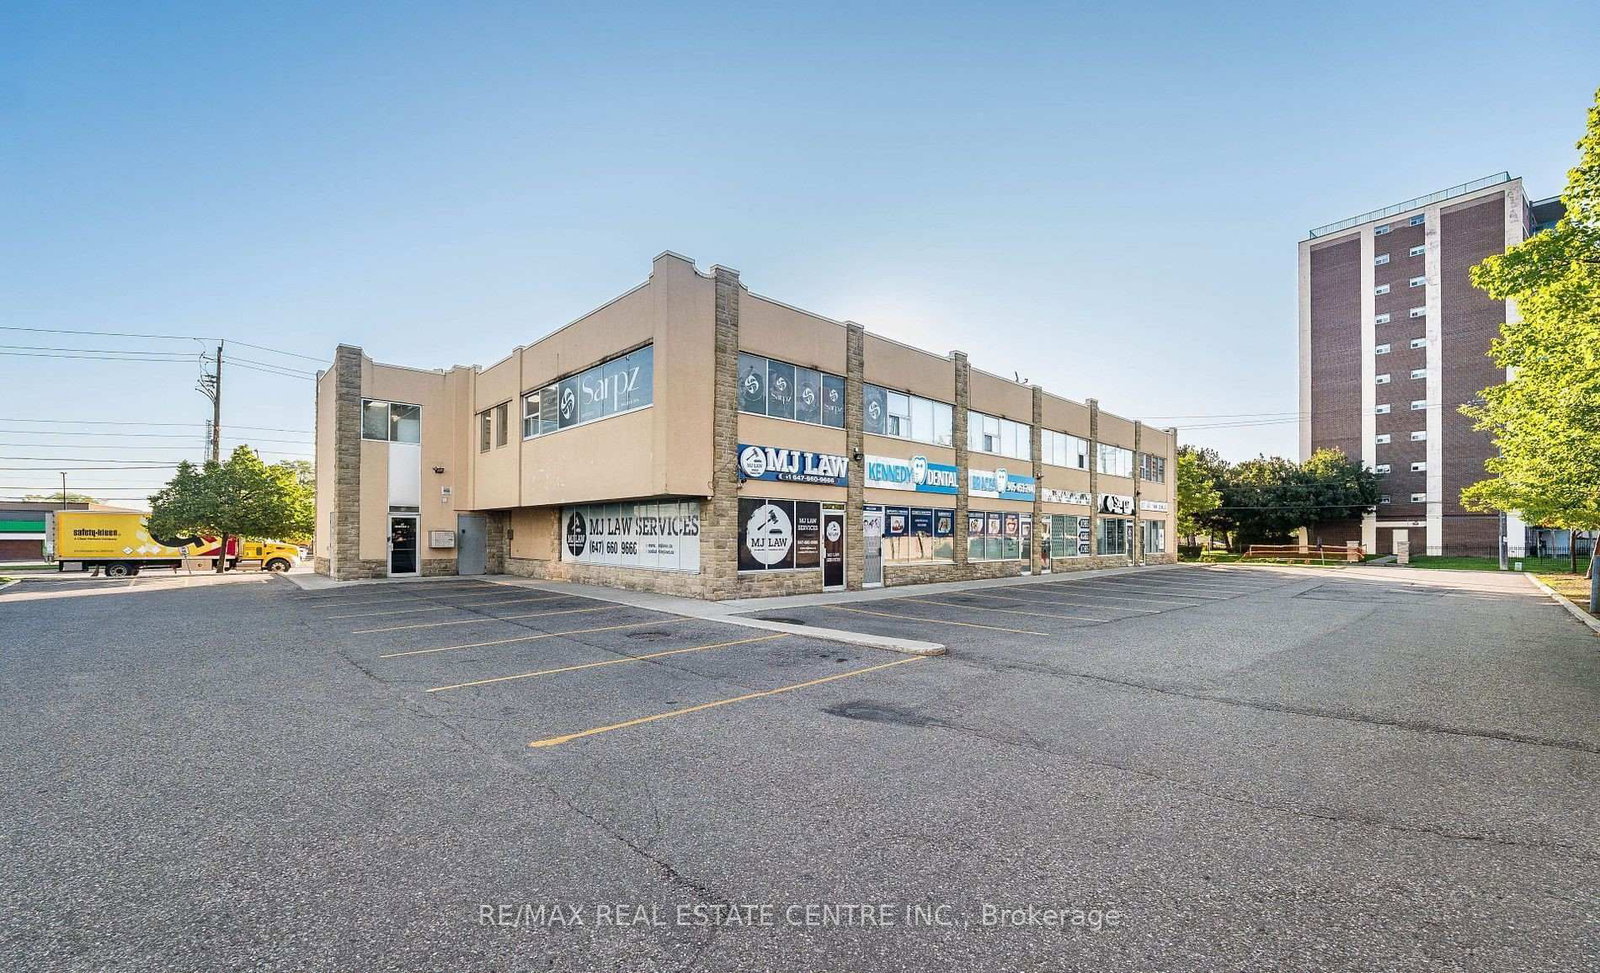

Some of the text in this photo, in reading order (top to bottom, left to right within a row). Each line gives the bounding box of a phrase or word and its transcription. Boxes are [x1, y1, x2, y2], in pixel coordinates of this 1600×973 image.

[582, 366, 640, 411] Sarpz
[765, 447, 849, 477] MJ LAW
[868, 462, 913, 484] KENNEDY
[928, 470, 959, 487] DENTAL
[589, 514, 699, 536] MJ LAW SERVICES
[751, 538, 766, 547] MJ
[768, 537, 788, 547] LAW
